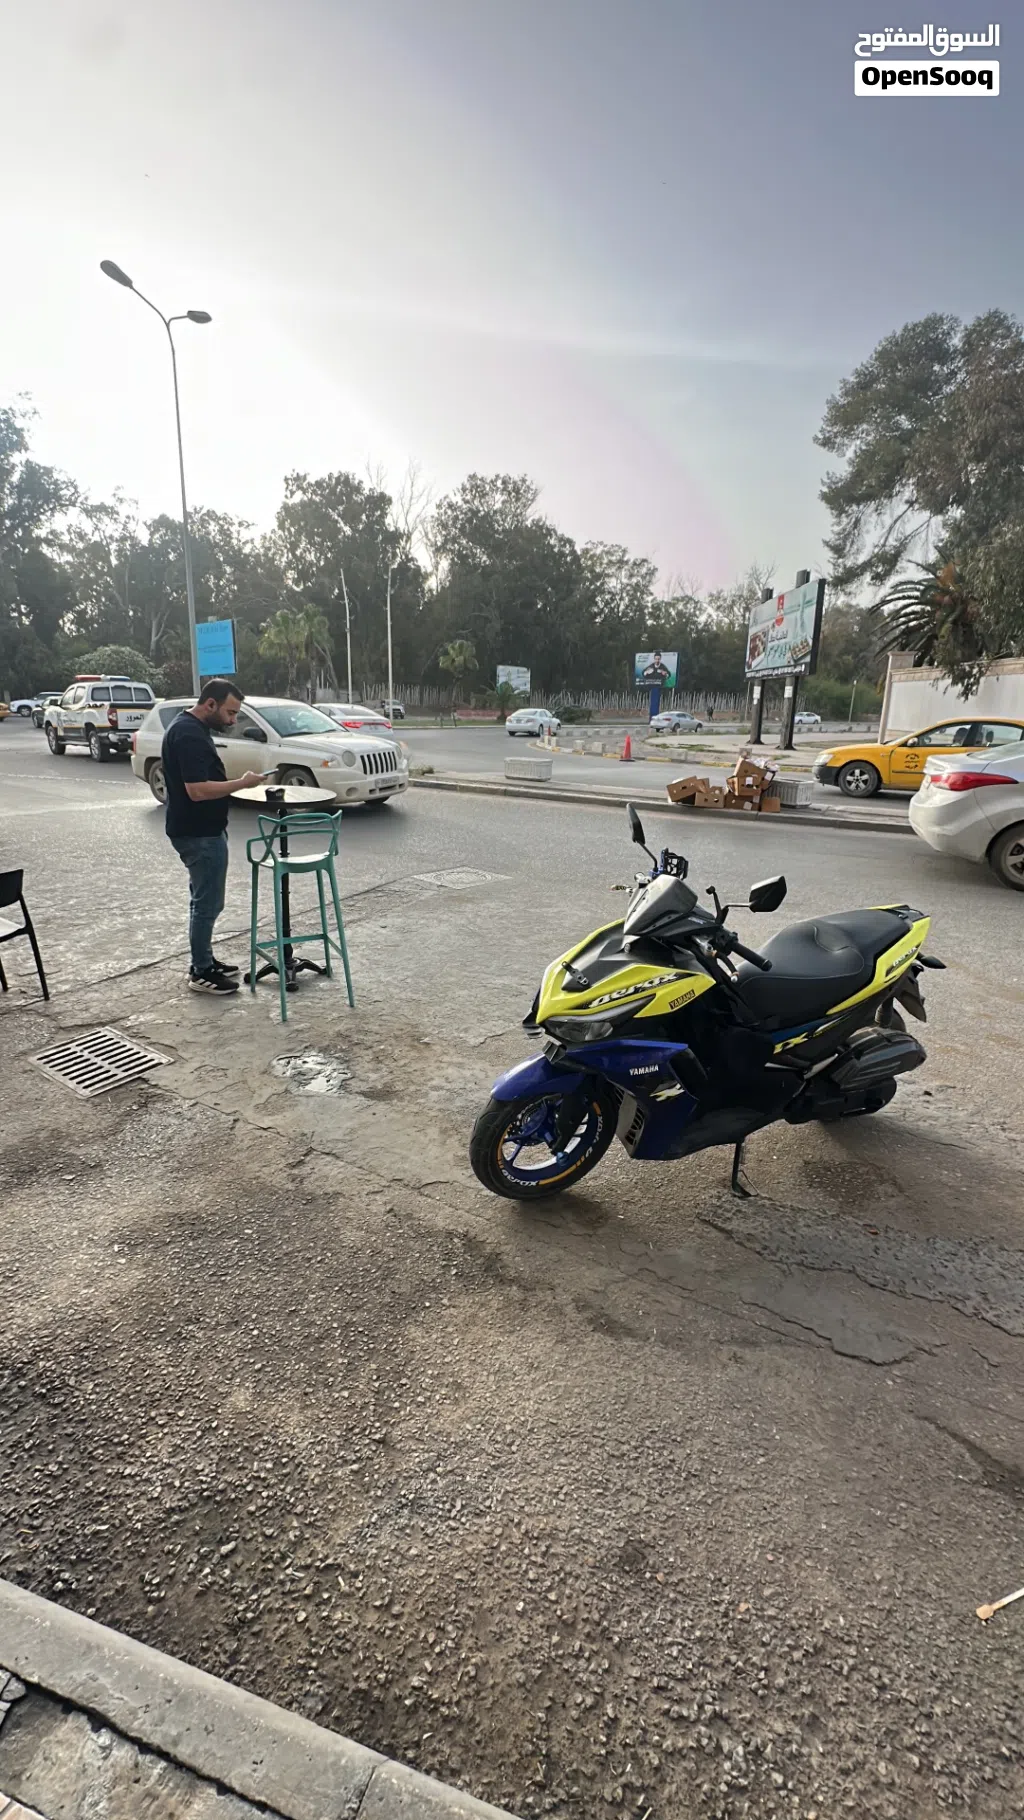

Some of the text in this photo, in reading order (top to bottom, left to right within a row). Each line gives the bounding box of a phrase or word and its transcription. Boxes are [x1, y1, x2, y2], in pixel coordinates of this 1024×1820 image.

[588, 972, 679, 1008] aerox
[668, 989, 696, 1010] YAMAHA
[629, 1064, 659, 1076] YAMAHA
[501, 1168, 539, 1187] aerox
